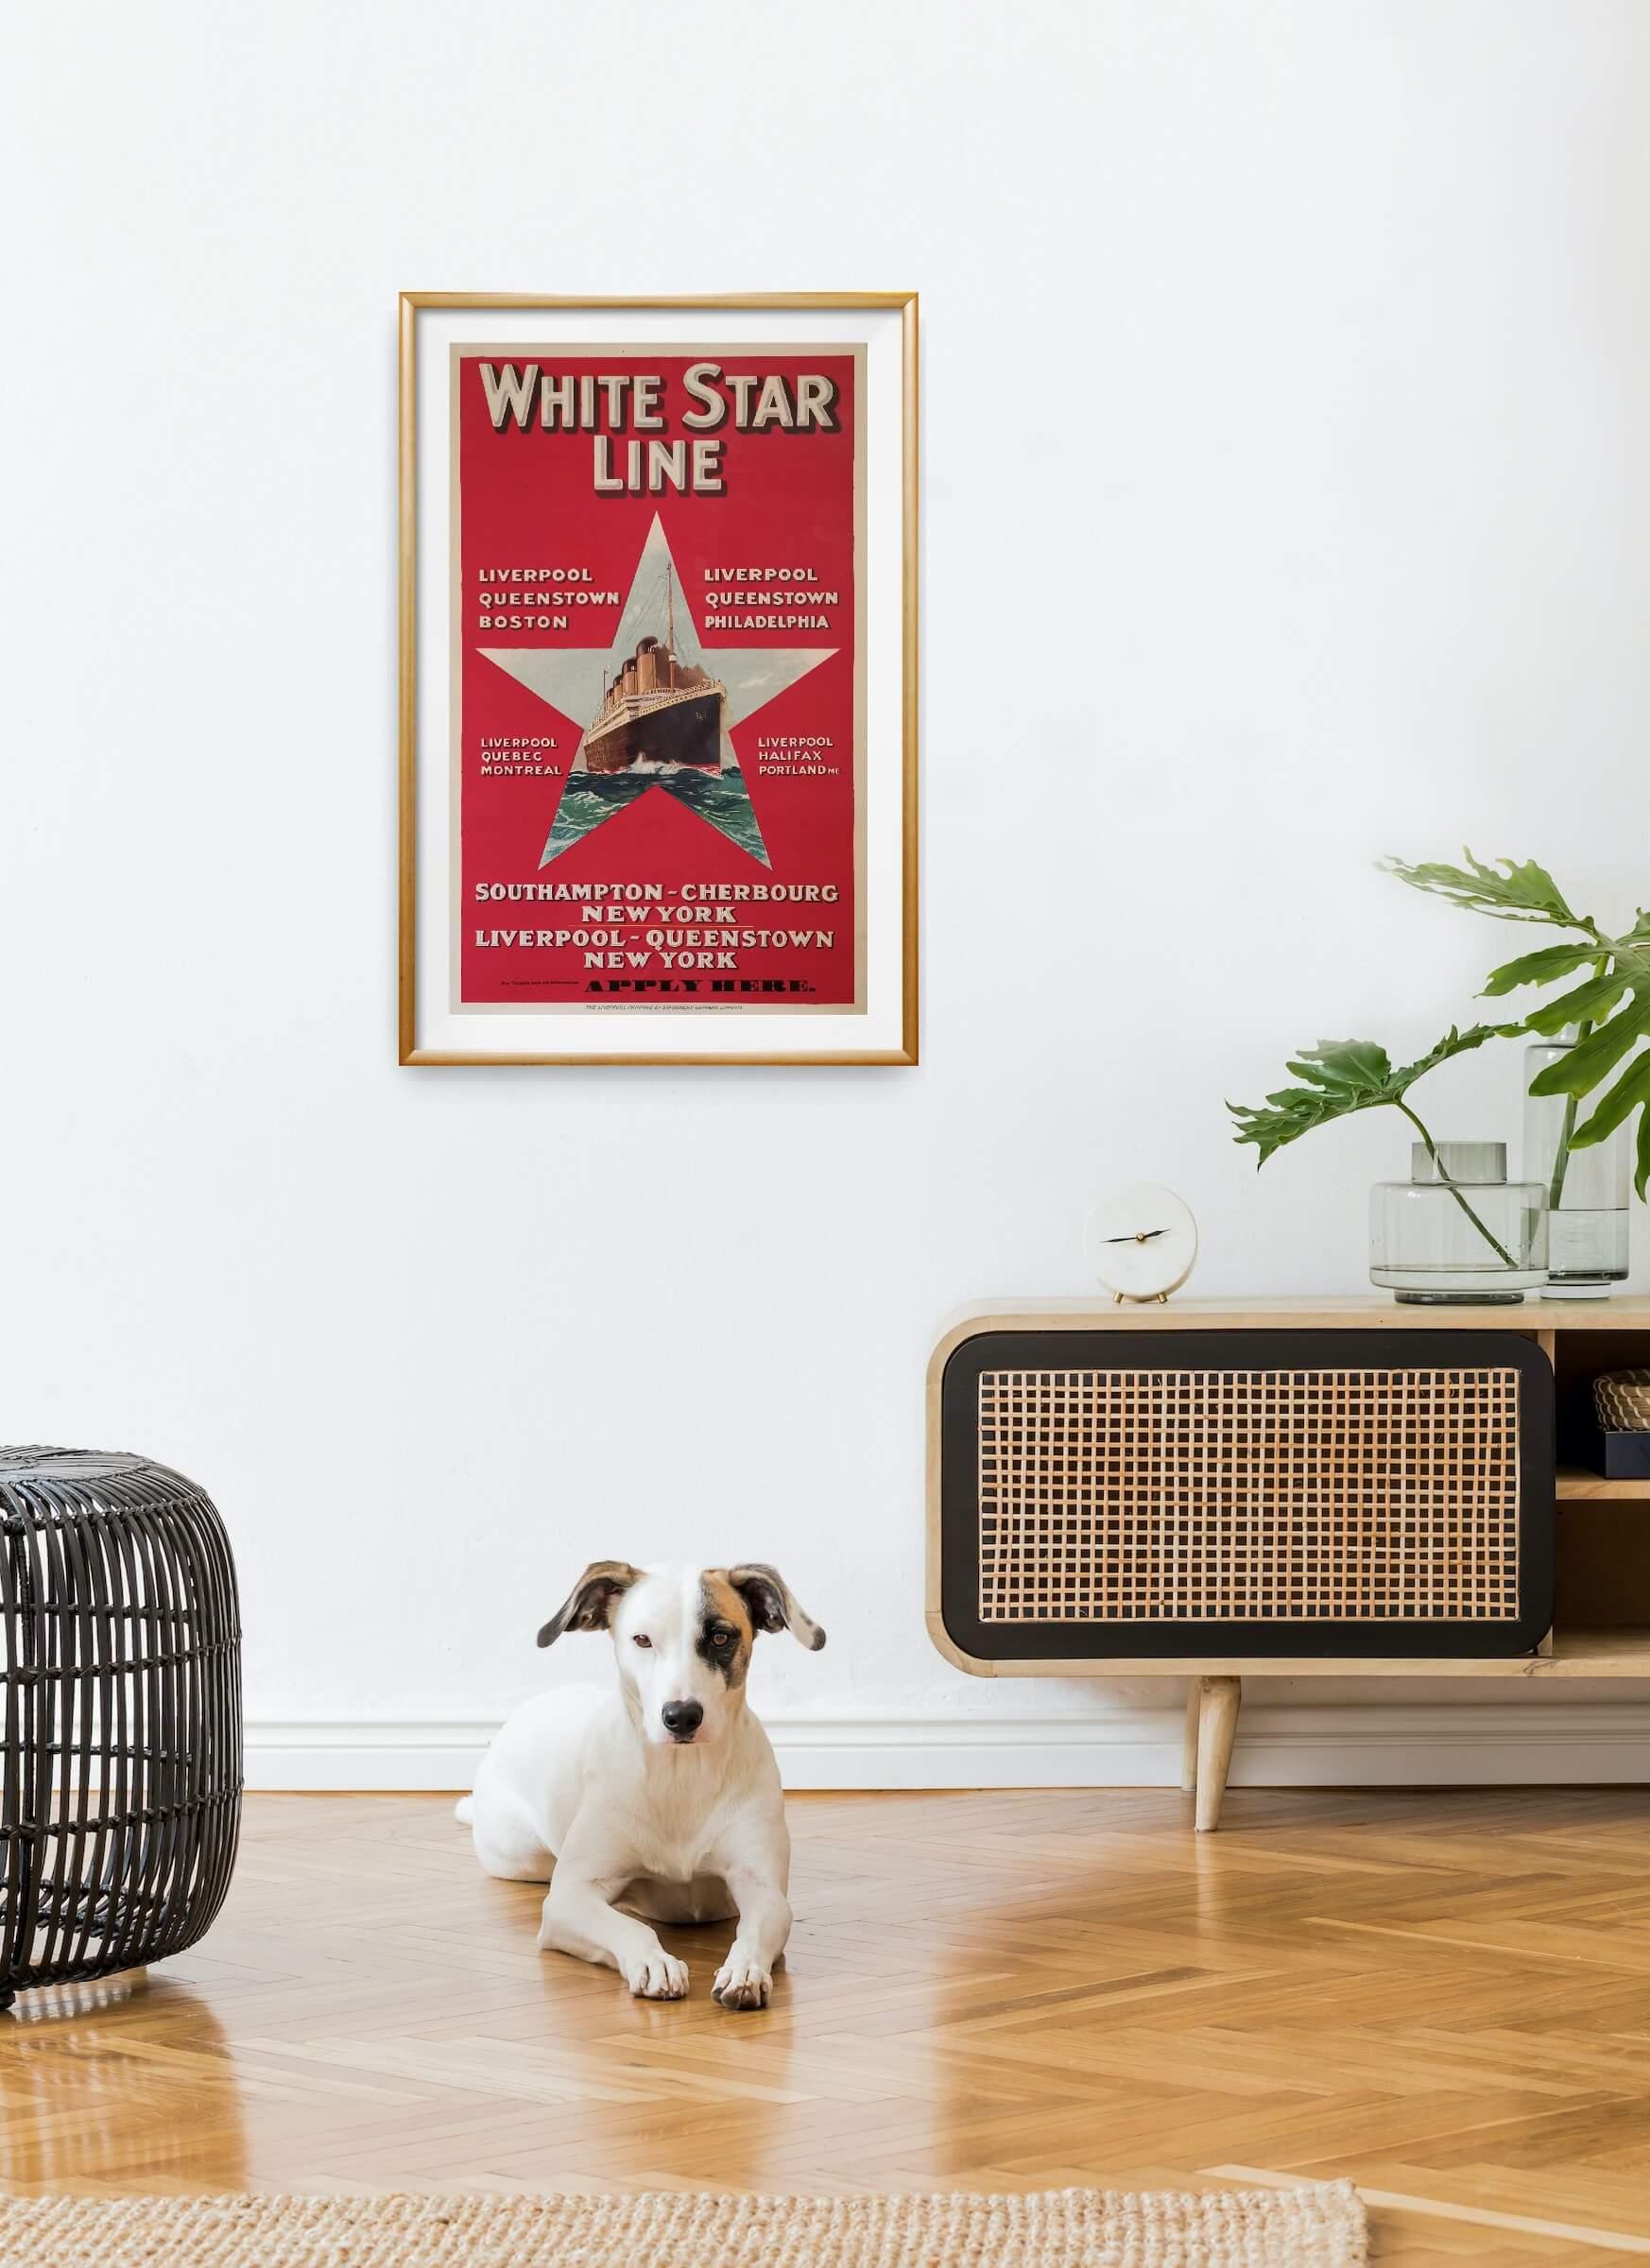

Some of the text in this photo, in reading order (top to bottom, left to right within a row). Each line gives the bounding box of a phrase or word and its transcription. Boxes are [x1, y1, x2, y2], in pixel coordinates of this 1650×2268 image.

[478, 362, 837, 431] WHITE STAR
[593, 435, 725, 494] LINE
[478, 568, 593, 582] LIVERPOOL
[704, 568, 818, 582] LIVERPOOL
[478, 592, 620, 610] QUEENSTOWN
[705, 592, 839, 610] QUEENSTOWN
[479, 615, 568, 629] BOSTON
[705, 615, 830, 629] PHILADELPHIA
[480, 737, 558, 747] LIVERPOOL
[758, 736, 834, 747] LIVERPOOL
[481, 751, 542, 763] QUEBEC
[759, 750, 822, 761] HALIFAX
[480, 765, 562, 776] MONTREAL
[759, 765, 827, 775] PORTLAND
[475, 883, 663, 902] SOUTHAMPTON
[680, 884, 840, 903] CHERBOURG
[581, 905, 737, 923] NEW YORK
[475, 929, 627, 947] LIVERPOOL
[645, 929, 834, 954] QUEENSTOWN
[583, 951, 738, 970] NEW YORK
[585, 979, 704, 993] APPLY
[710, 979, 817, 993] HERE.
